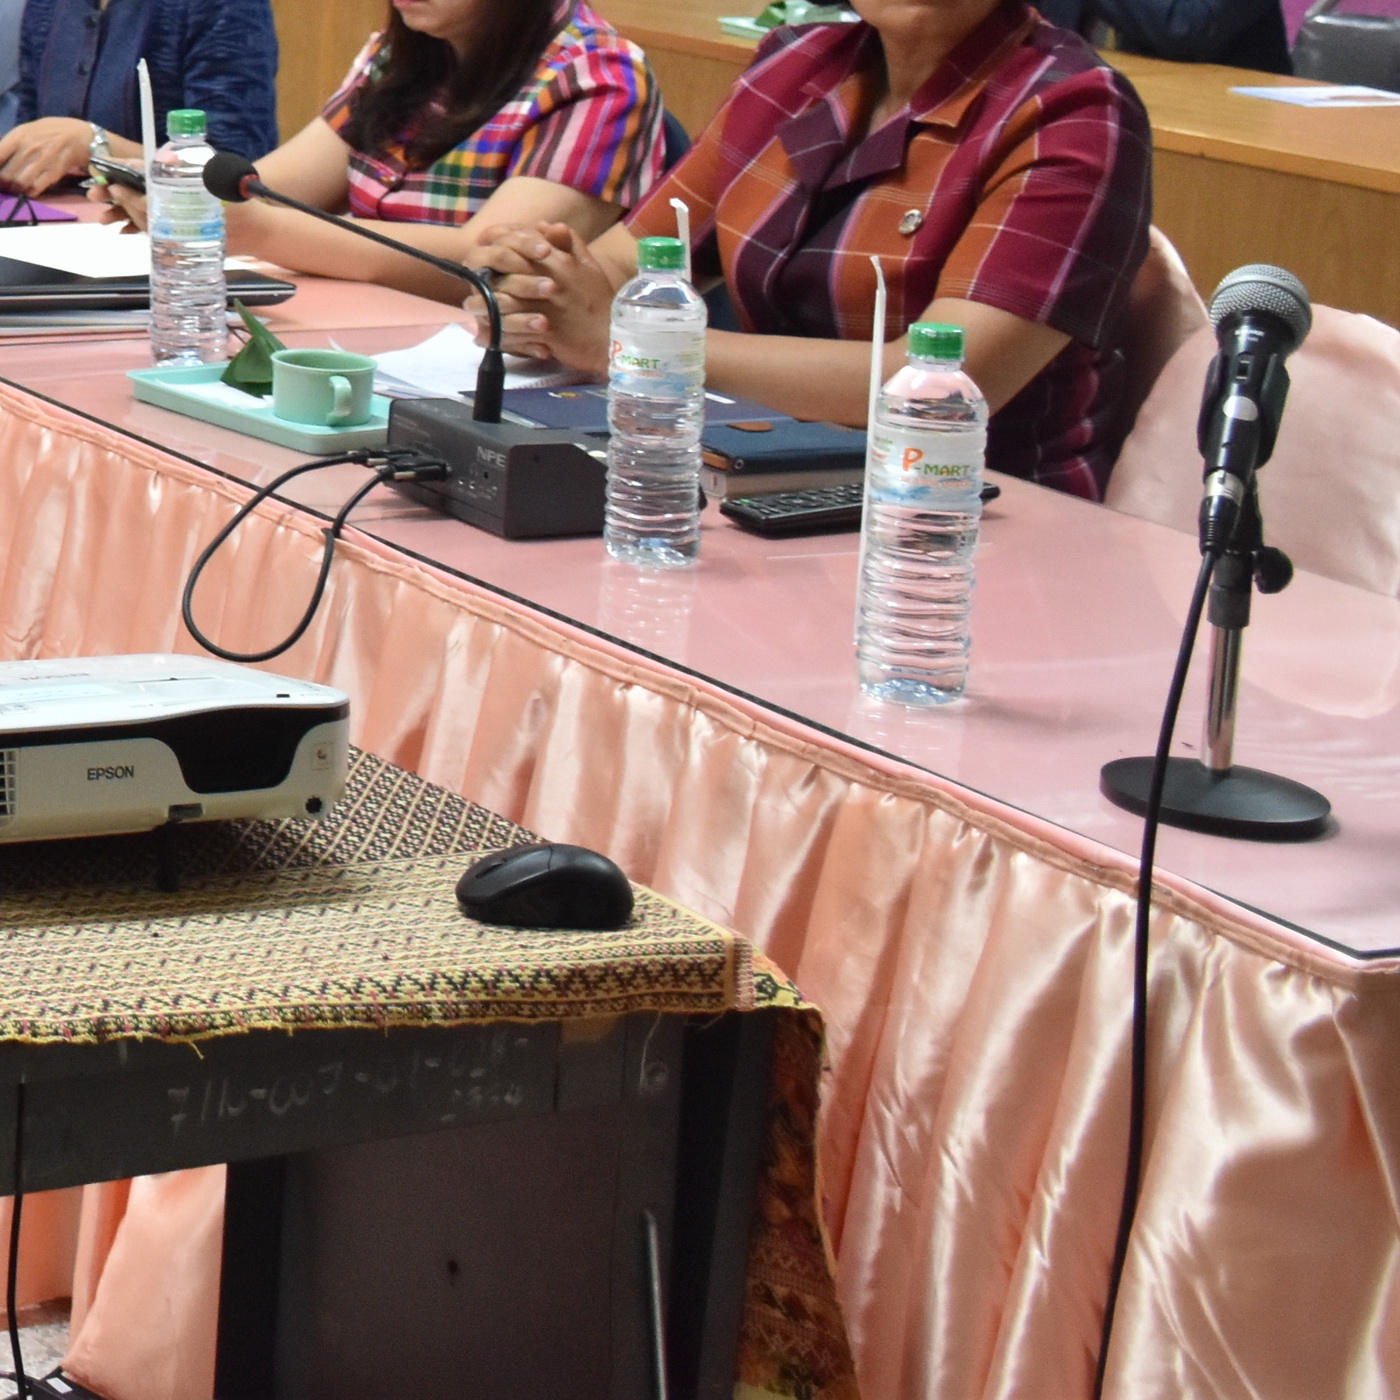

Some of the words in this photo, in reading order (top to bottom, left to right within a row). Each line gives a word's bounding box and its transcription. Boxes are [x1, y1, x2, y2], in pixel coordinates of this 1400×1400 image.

[477, 445, 507, 468] NPE
[902, 446, 971, 476] P-MART
[86, 765, 135, 781] EPSON
